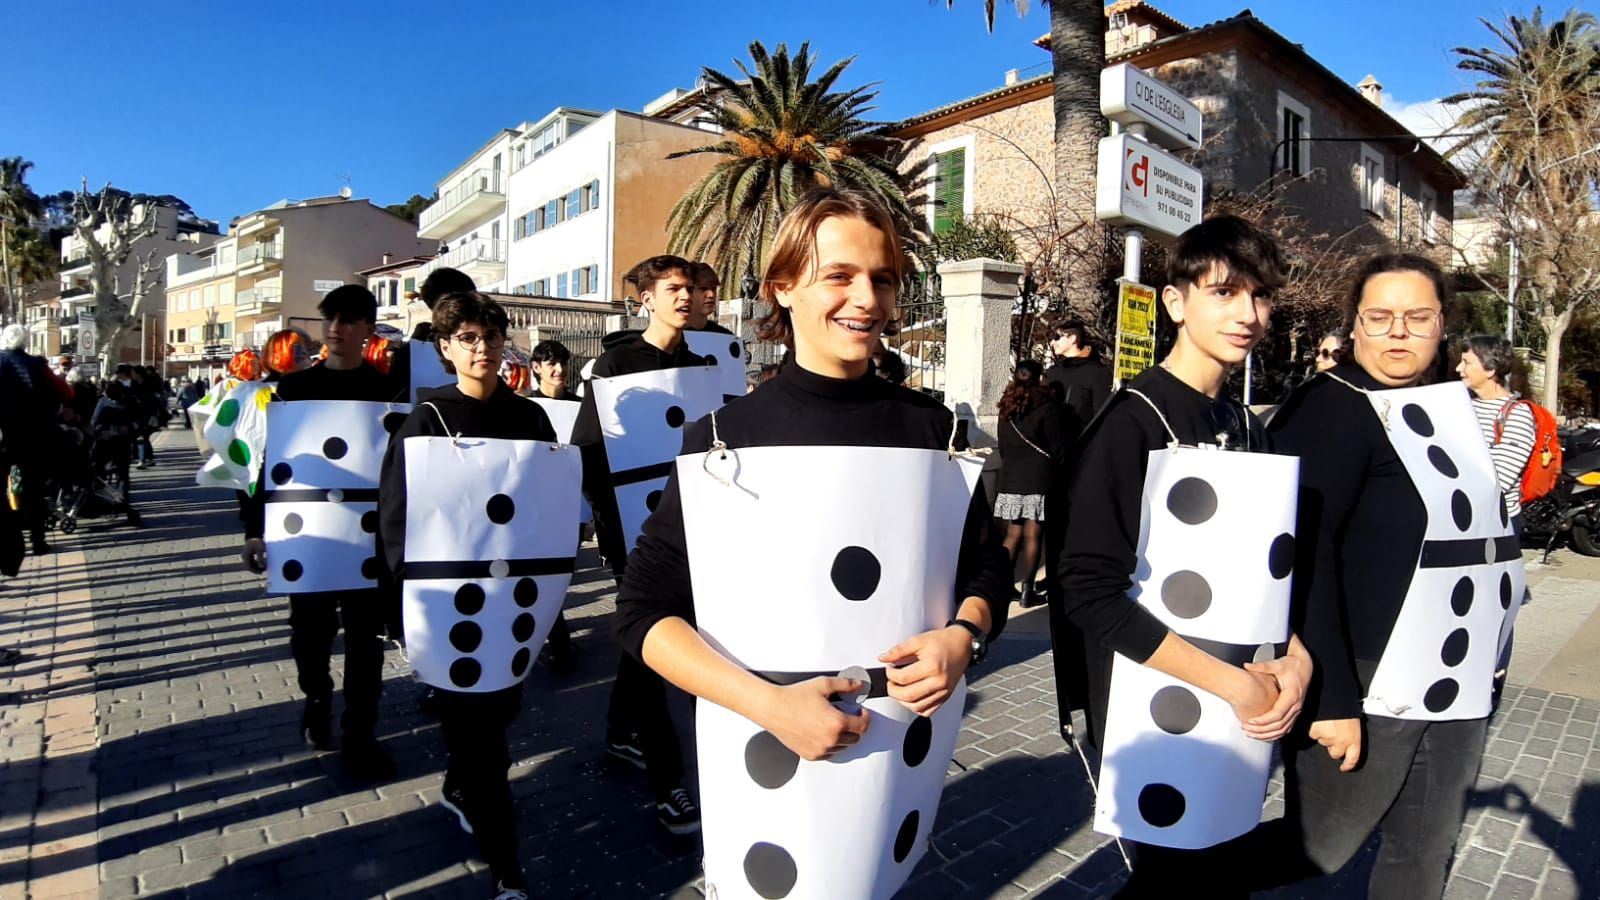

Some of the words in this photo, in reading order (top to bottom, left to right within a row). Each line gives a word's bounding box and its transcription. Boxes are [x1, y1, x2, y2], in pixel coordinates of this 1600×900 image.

[1136, 81, 1144, 99] C/
[1144, 86, 1153, 105] DE
[1153, 166, 1183, 187] DISPONIBLE
[1184, 180, 1196, 193] PARA
[1156, 184, 1163, 195] SU
[1164, 187, 1194, 208] PUBLICIDAD
[1158, 201, 1168, 214] 971
[1184, 212, 1191, 223] 22
